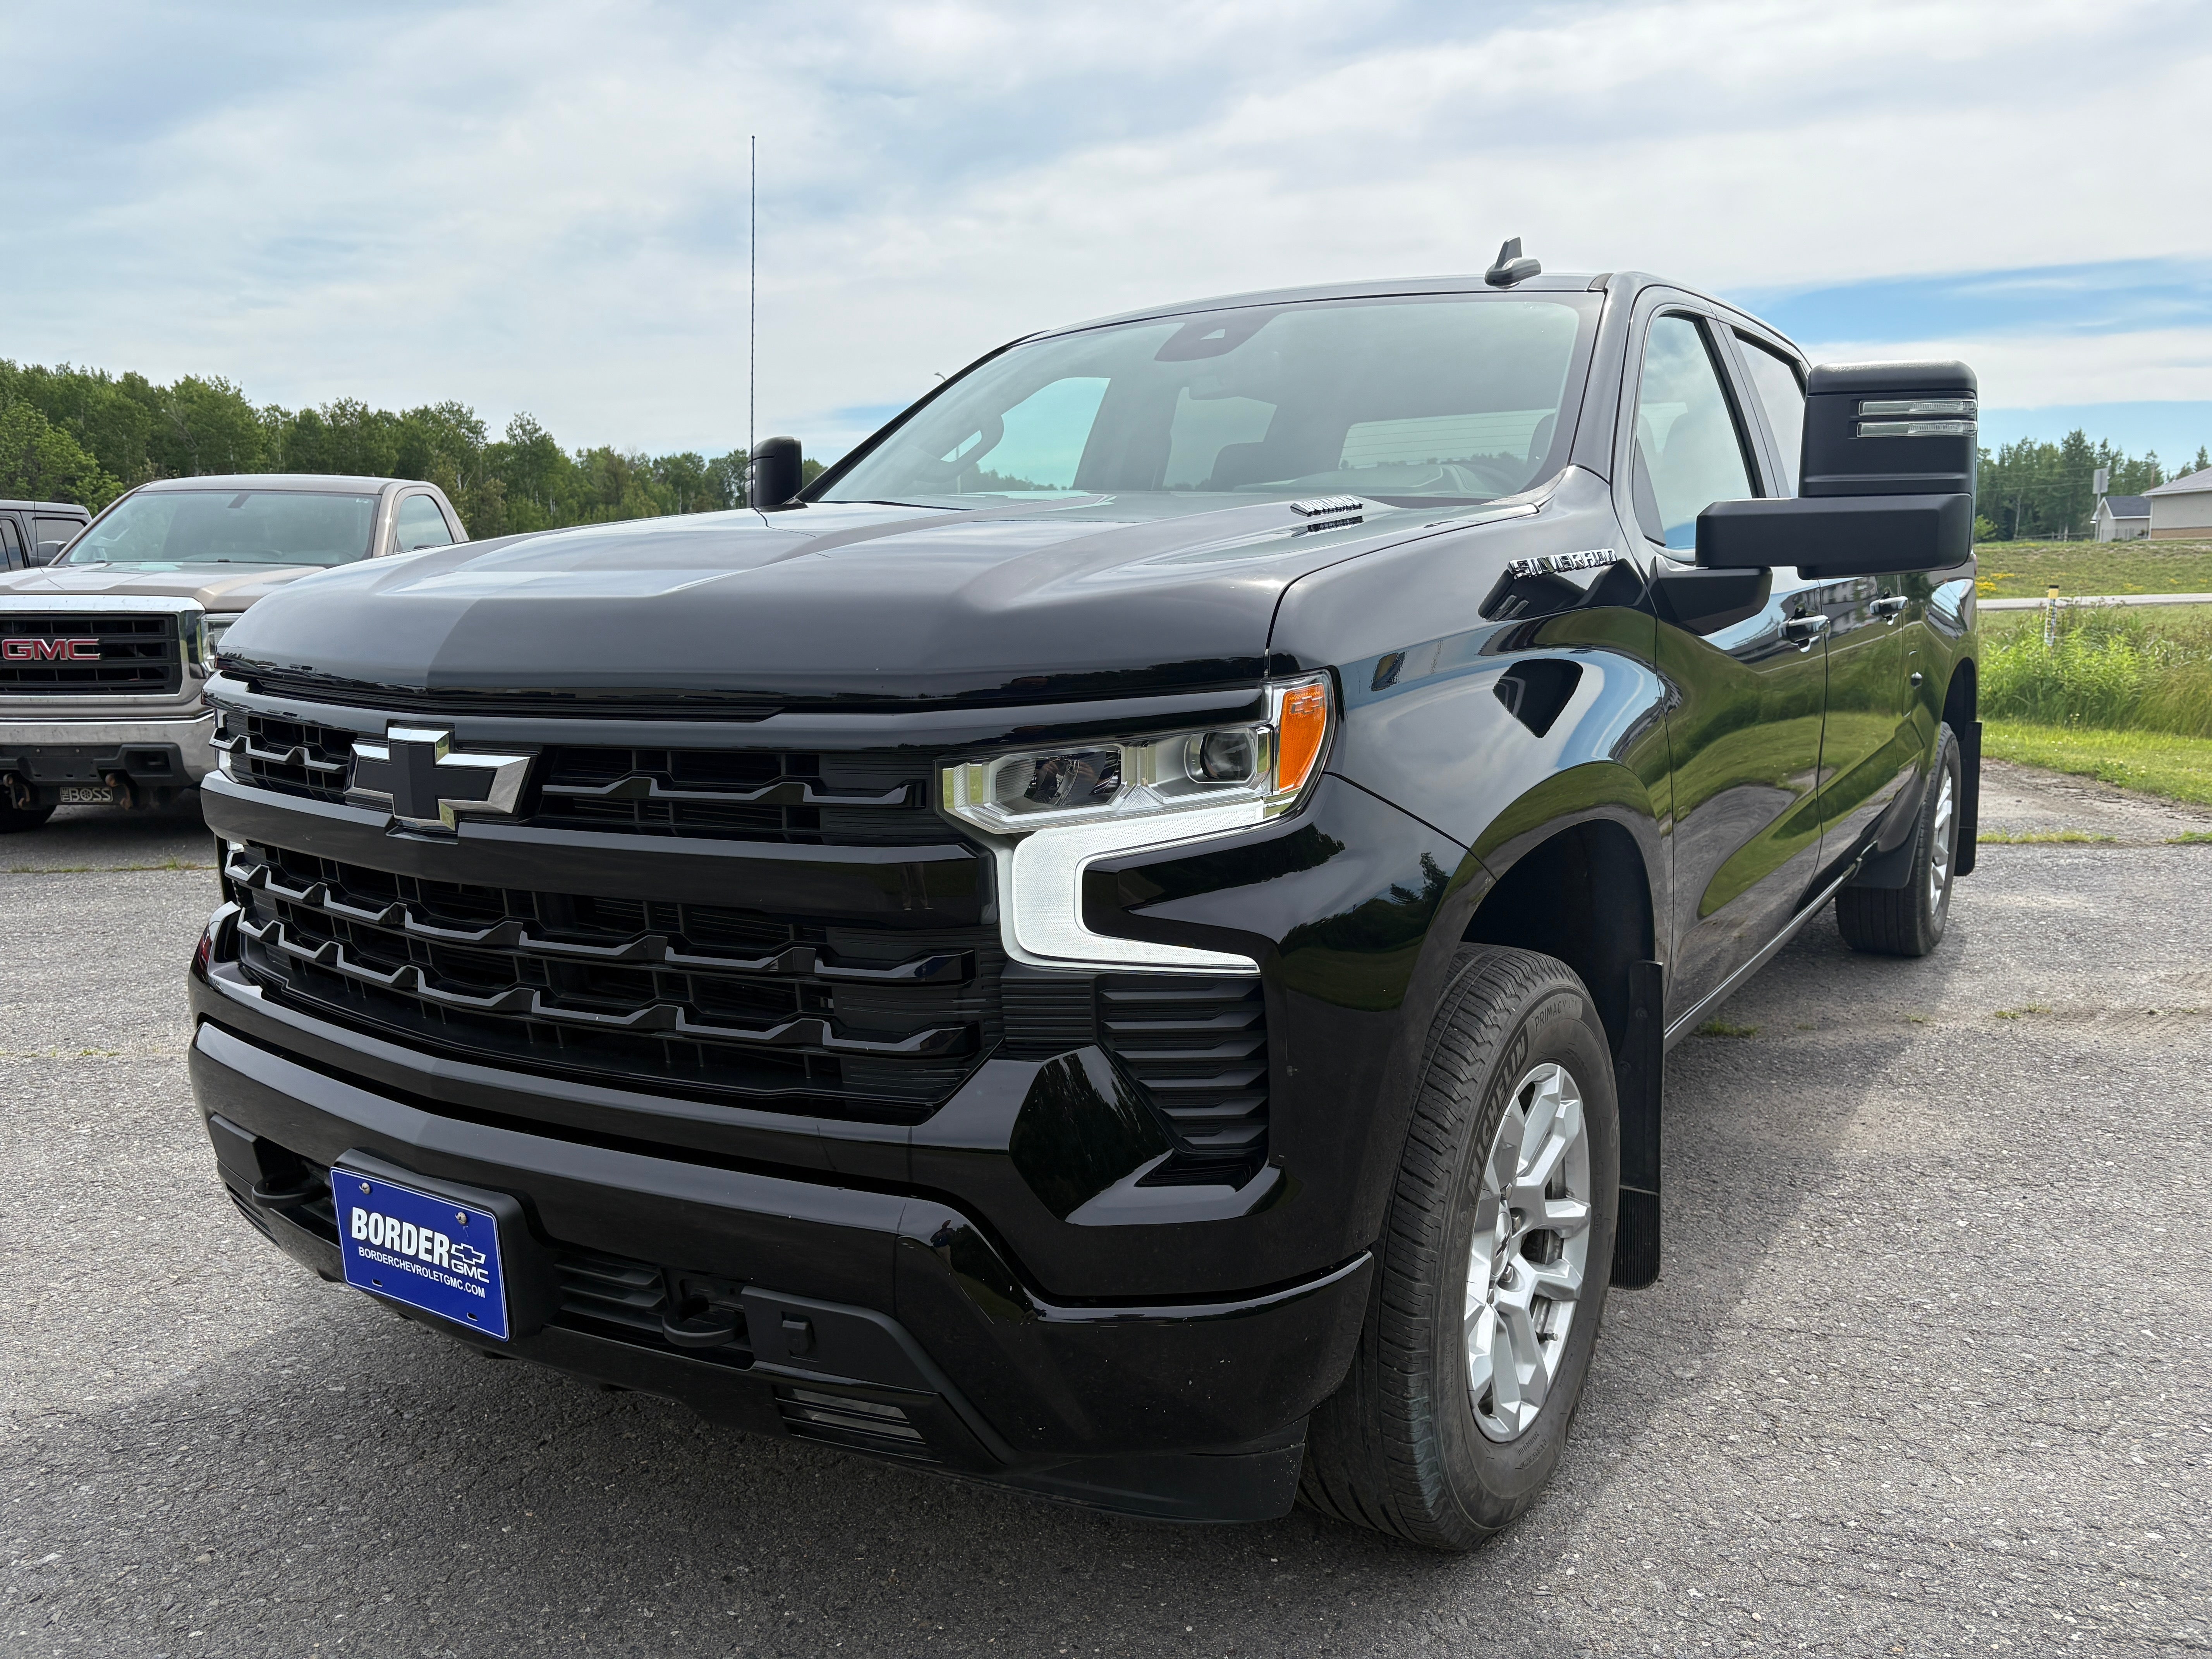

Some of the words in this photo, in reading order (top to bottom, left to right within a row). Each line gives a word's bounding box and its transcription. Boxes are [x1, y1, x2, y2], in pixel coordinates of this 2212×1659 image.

[1298, 495, 1364, 515] DURAMAX
[2, 638, 100, 660] GMC
[69, 788, 111, 801] BOSS
[1535, 1000, 1566, 1032] PRIMACY
[1468, 1036, 1525, 1199] MICHELIN
[351, 1206, 450, 1268] BORDER
[358, 1246, 486, 1298] BORDERCHEVROLETGMC.COM
[451, 1259, 490, 1283] GMC
